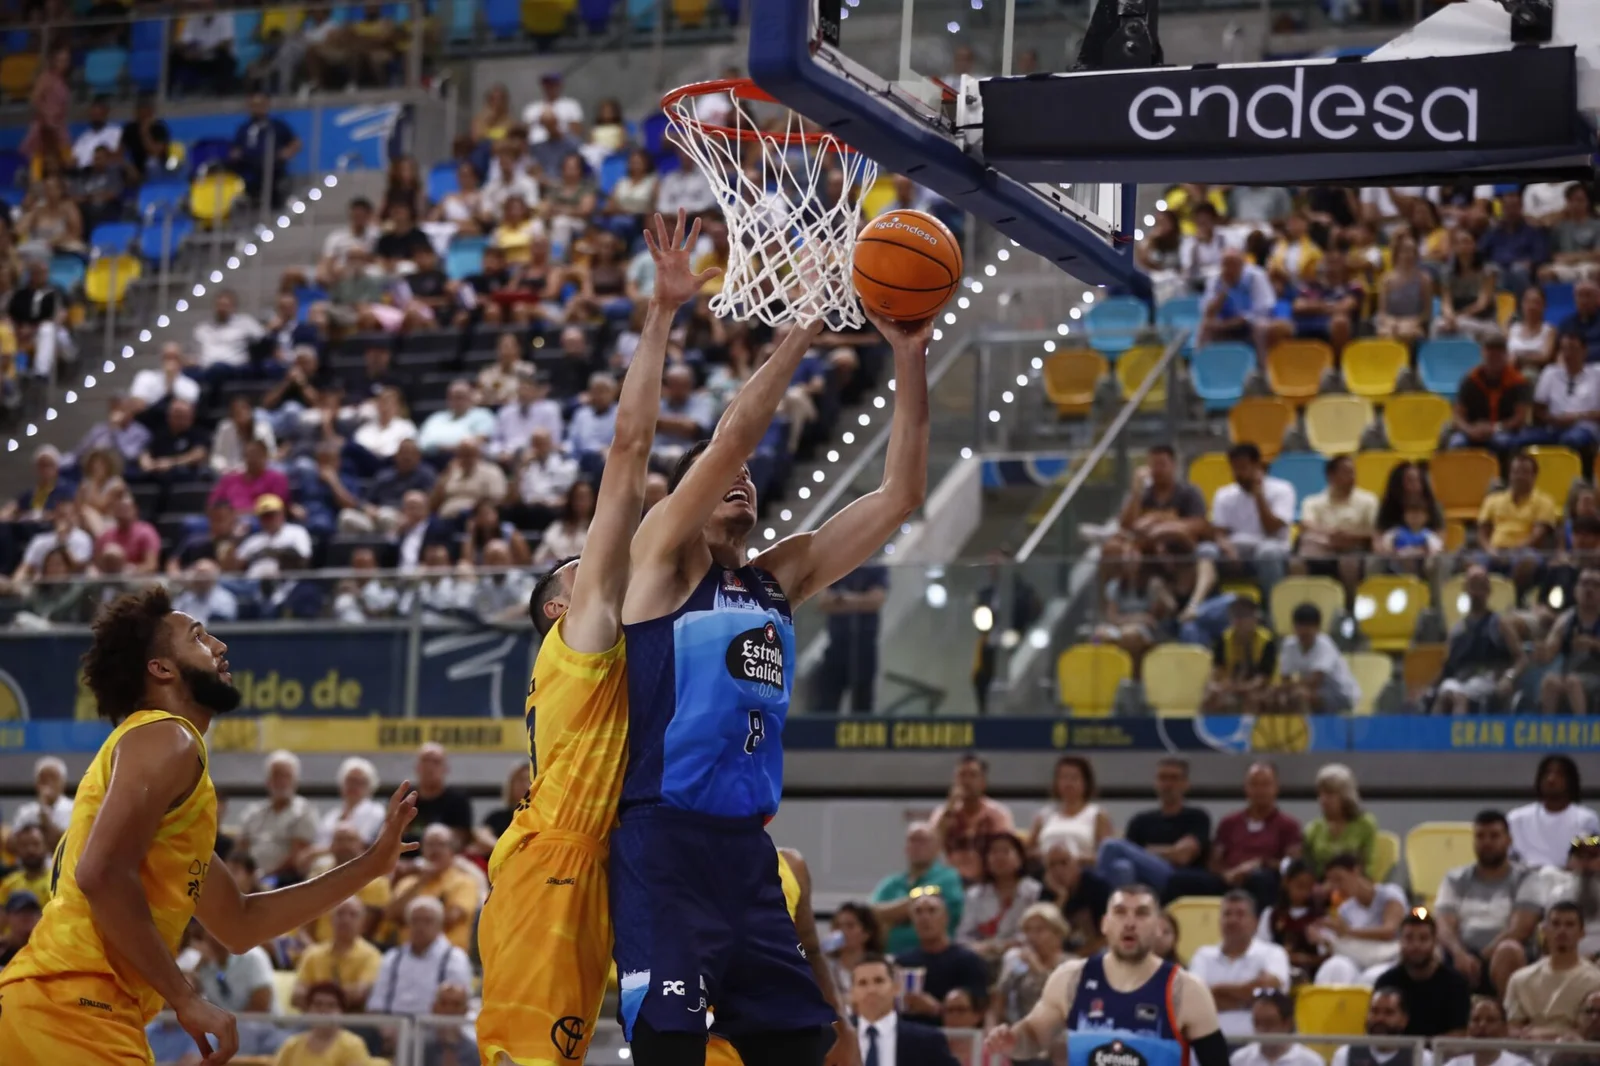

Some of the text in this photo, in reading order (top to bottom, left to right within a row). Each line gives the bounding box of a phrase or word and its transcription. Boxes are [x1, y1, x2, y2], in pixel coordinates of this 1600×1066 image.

[1128, 67, 1478, 142] endesa
[741, 639, 783, 668] Estrella
[743, 658, 783, 686] Galicia
[311, 668, 363, 710] de
[743, 709, 765, 755] 8
[835, 722, 974, 748] GRAN CANARIA
[1451, 720, 1600, 747] GRAN CANARIA
[662, 980, 686, 996] PG
